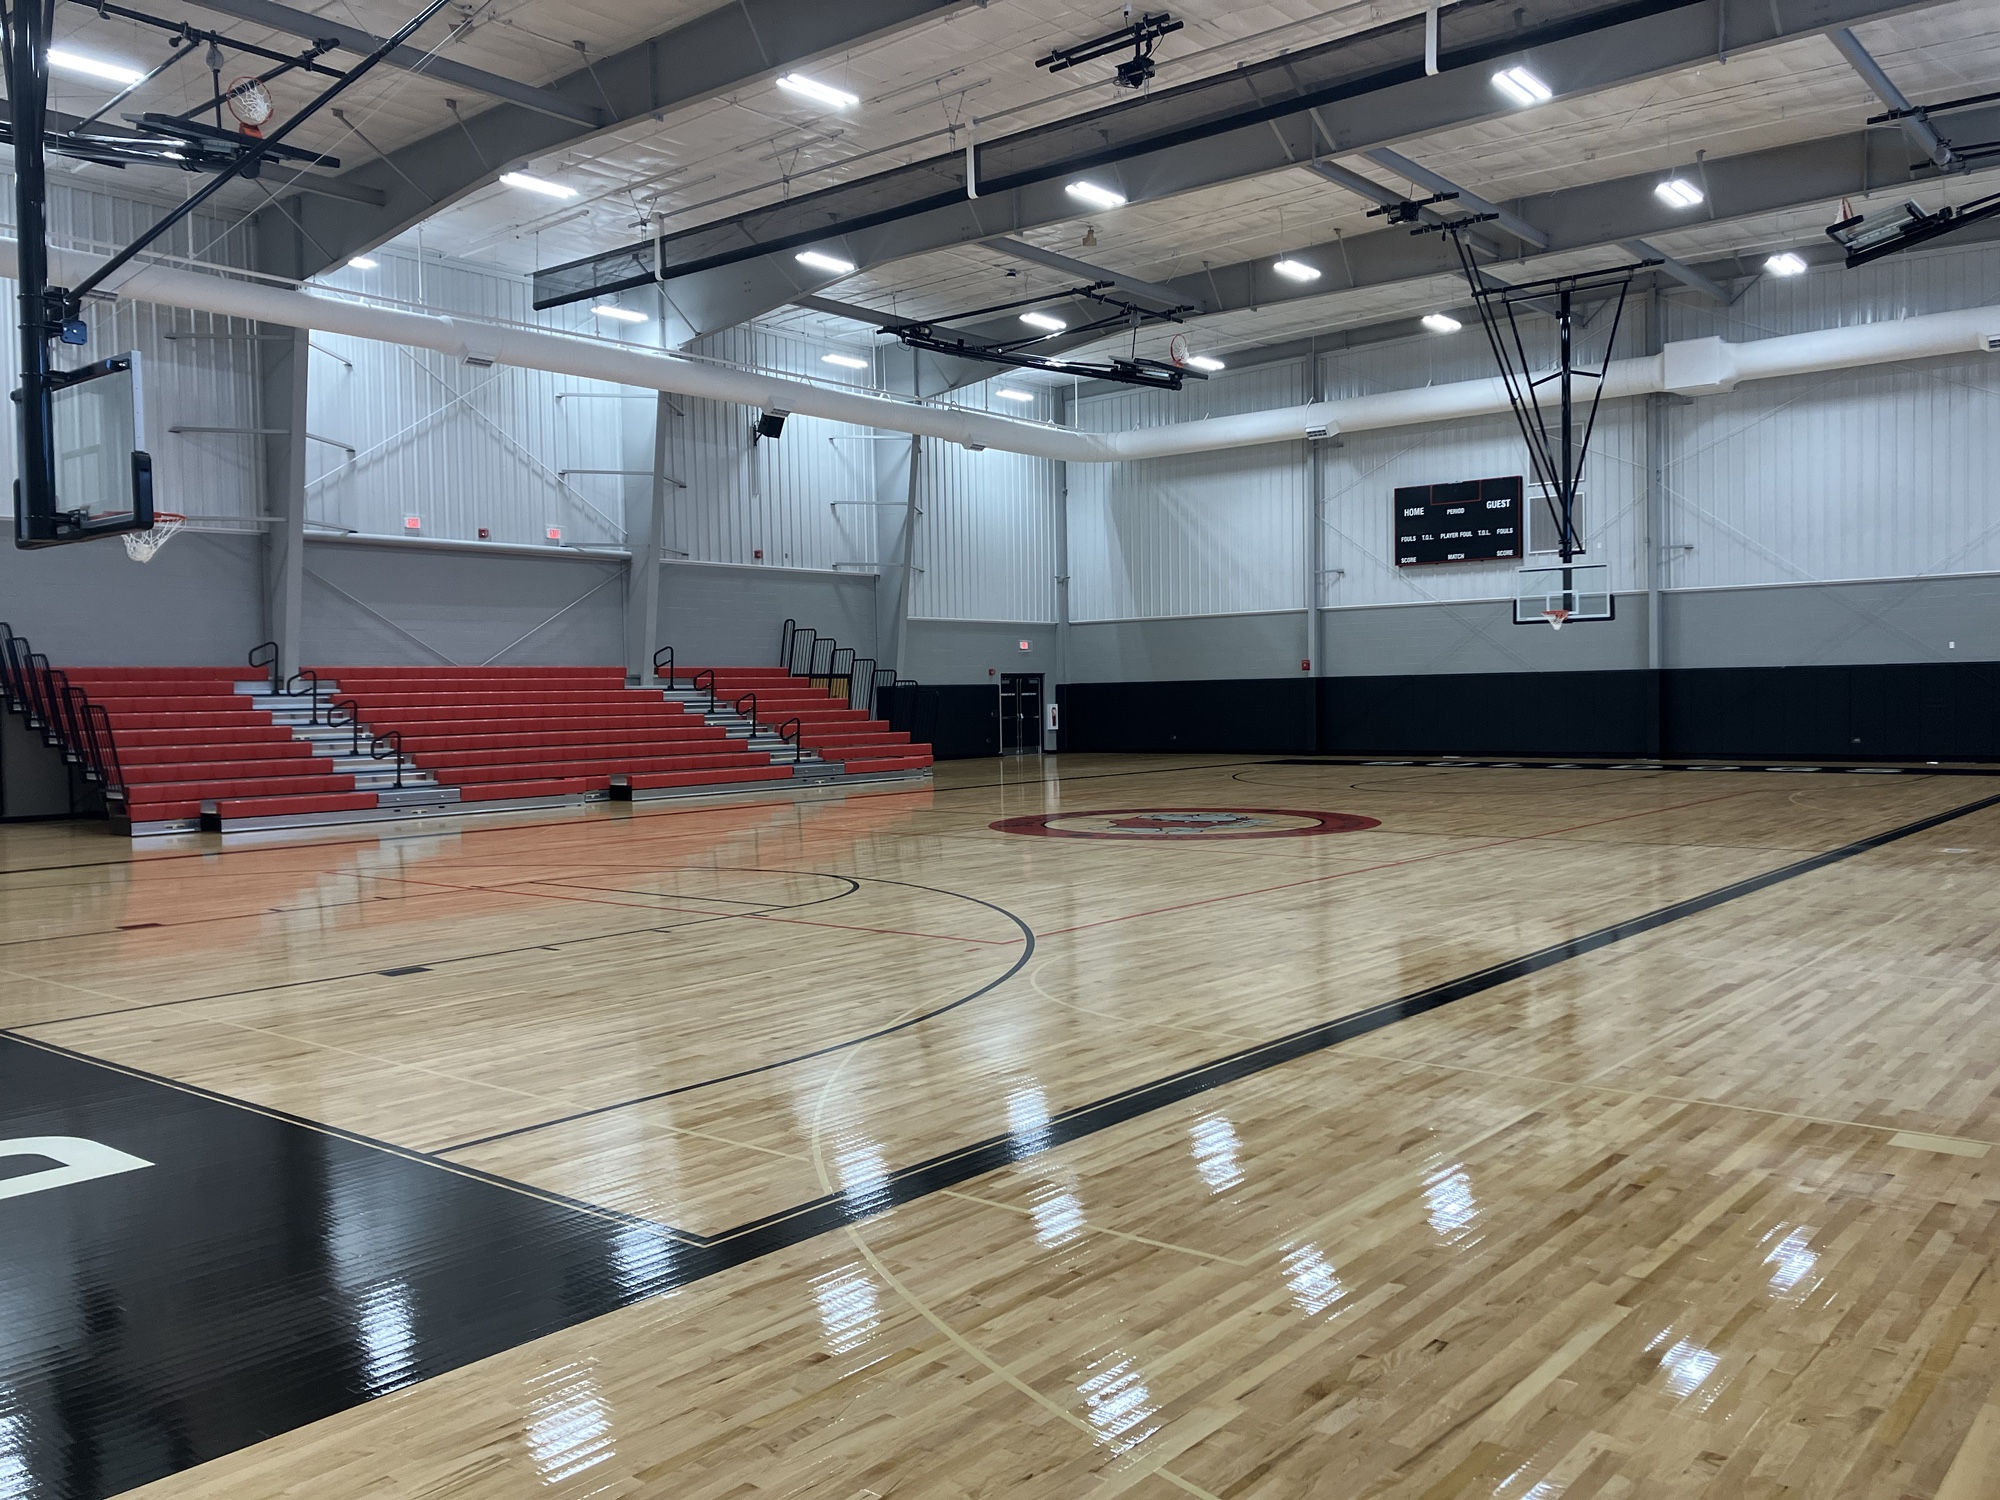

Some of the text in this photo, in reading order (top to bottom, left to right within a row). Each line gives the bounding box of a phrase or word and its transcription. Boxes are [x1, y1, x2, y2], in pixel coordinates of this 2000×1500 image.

[1486, 499, 1511, 509] GUEST
[1404, 507, 1425, 517] HOME
[1446, 507, 1465, 515] PERIOD
